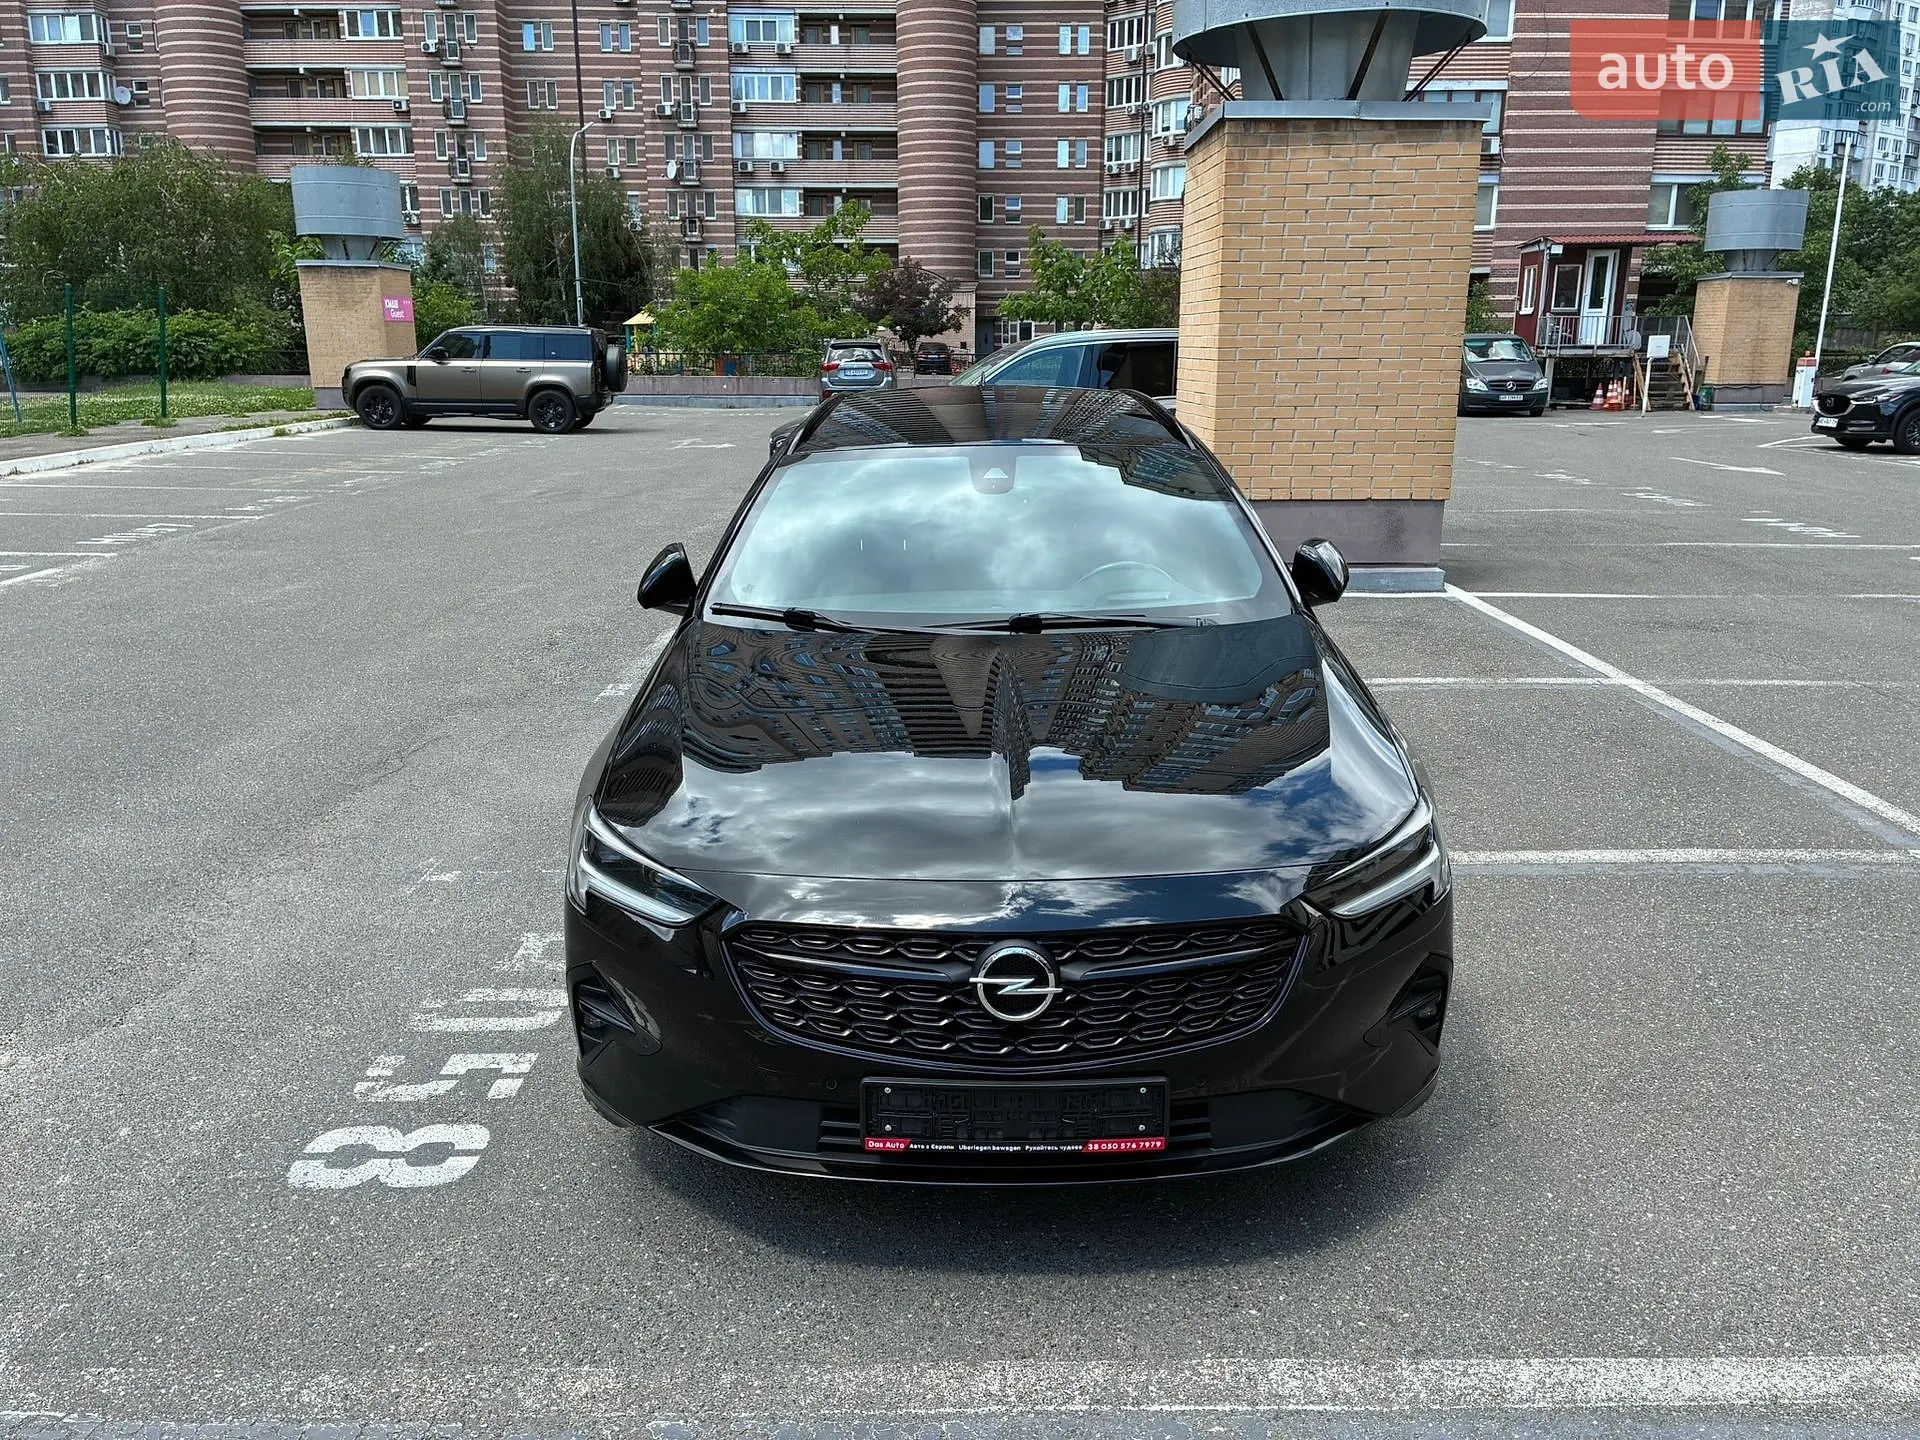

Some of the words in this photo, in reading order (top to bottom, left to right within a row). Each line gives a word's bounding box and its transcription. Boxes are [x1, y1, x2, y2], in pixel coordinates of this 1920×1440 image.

[868, 1140, 883, 1148] Das
[885, 1141, 905, 1149] Auto
[1101, 1142, 1118, 1150] 050
